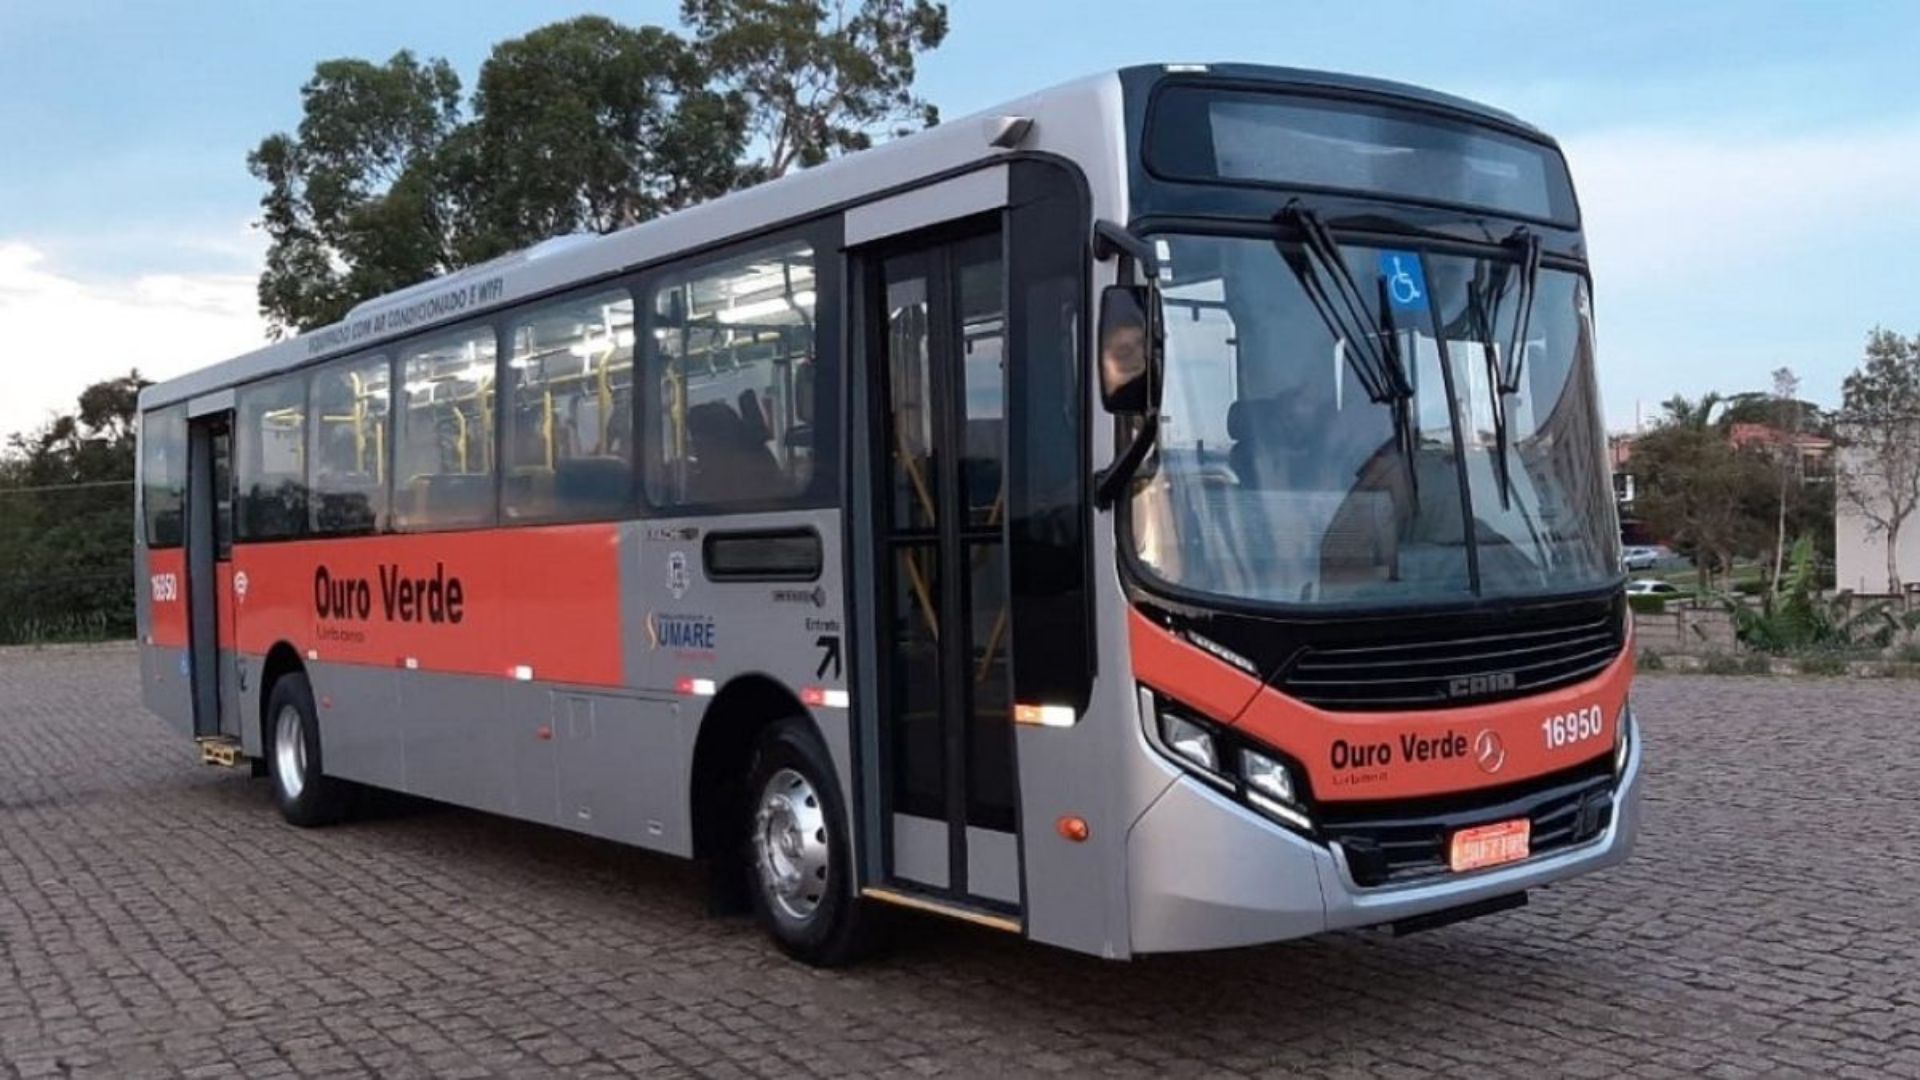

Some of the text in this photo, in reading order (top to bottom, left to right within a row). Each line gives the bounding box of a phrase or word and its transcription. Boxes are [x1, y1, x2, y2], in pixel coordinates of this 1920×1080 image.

[388, 290, 466, 328] CONDICIONADO
[151, 572, 177, 602] 16950
[315, 561, 464, 625] Ouro Verde
[1450, 671, 1516, 697] CAIO
[1541, 704, 1604, 750] 16950
[1330, 730, 1468, 770] Ouro Verde
